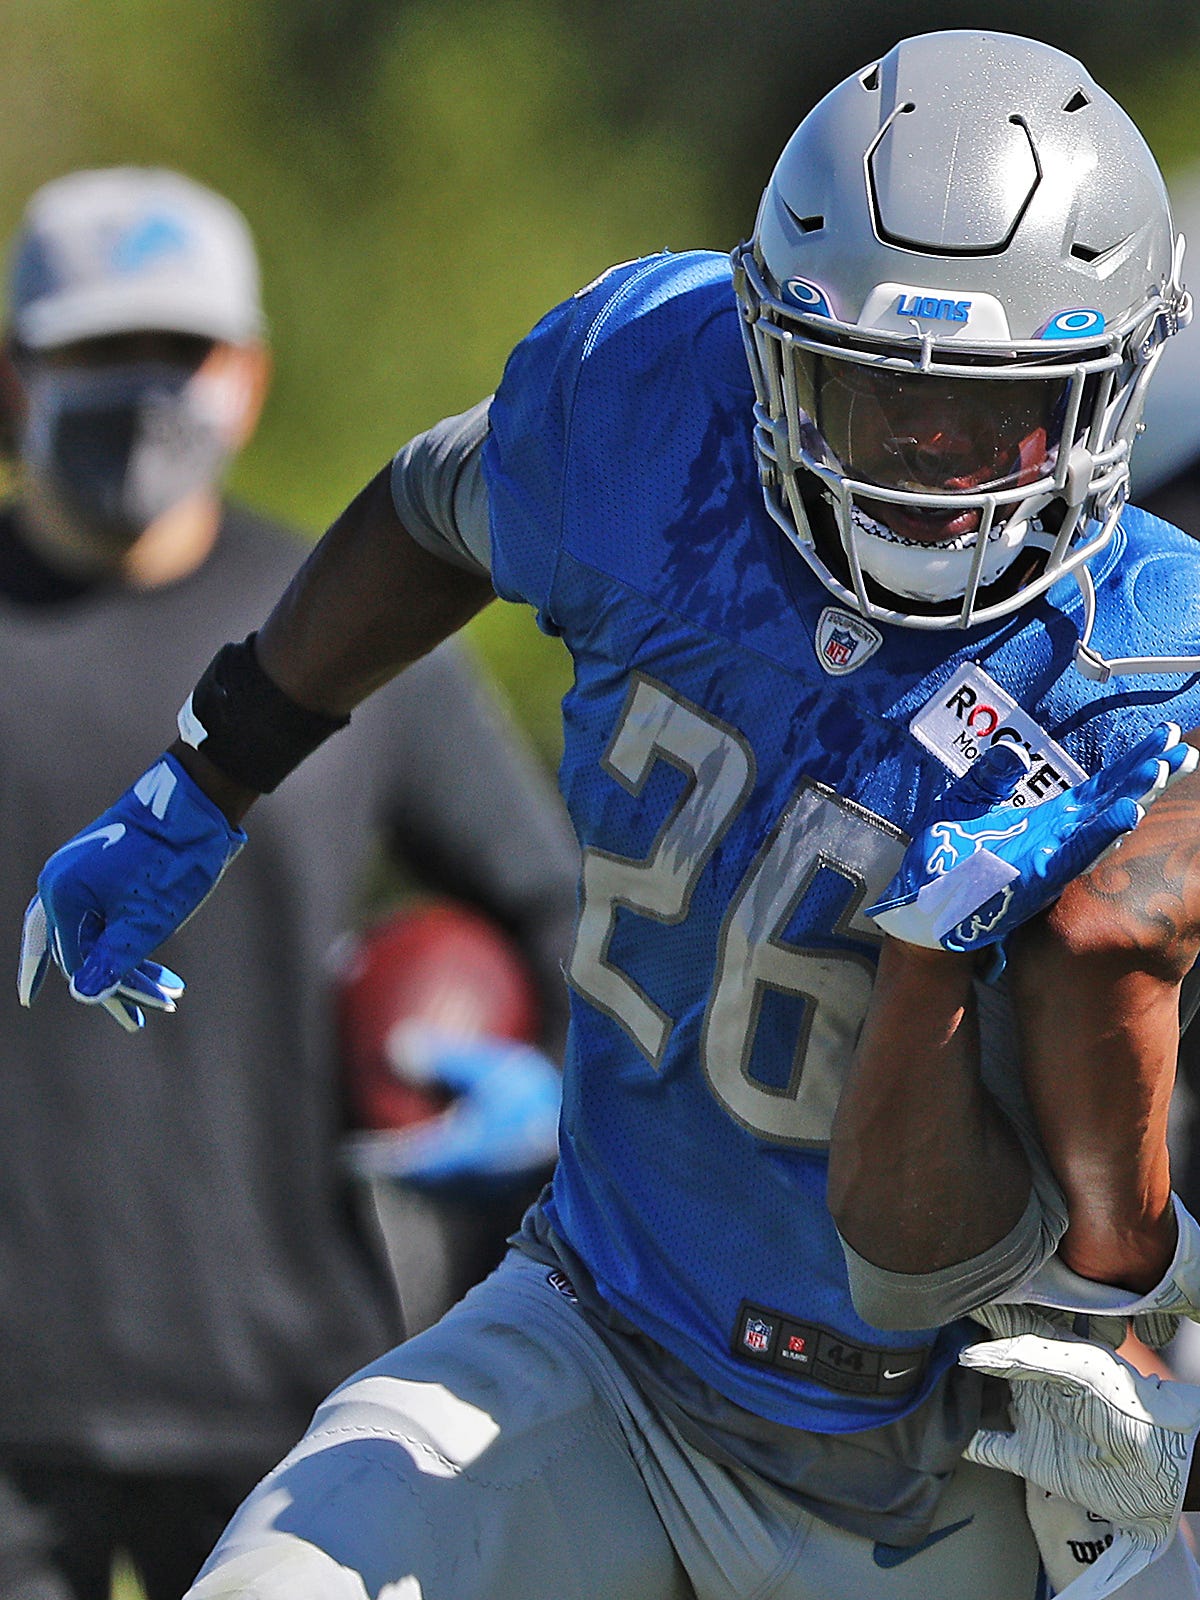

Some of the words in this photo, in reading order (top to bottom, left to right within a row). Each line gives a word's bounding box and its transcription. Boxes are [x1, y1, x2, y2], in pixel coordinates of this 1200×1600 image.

[897, 294, 972, 322] LIONS
[825, 639, 851, 665] NFL
[945, 684, 1072, 799] ROCE
[567, 669, 913, 1148] 26
[747, 1331, 768, 1350] NFL
